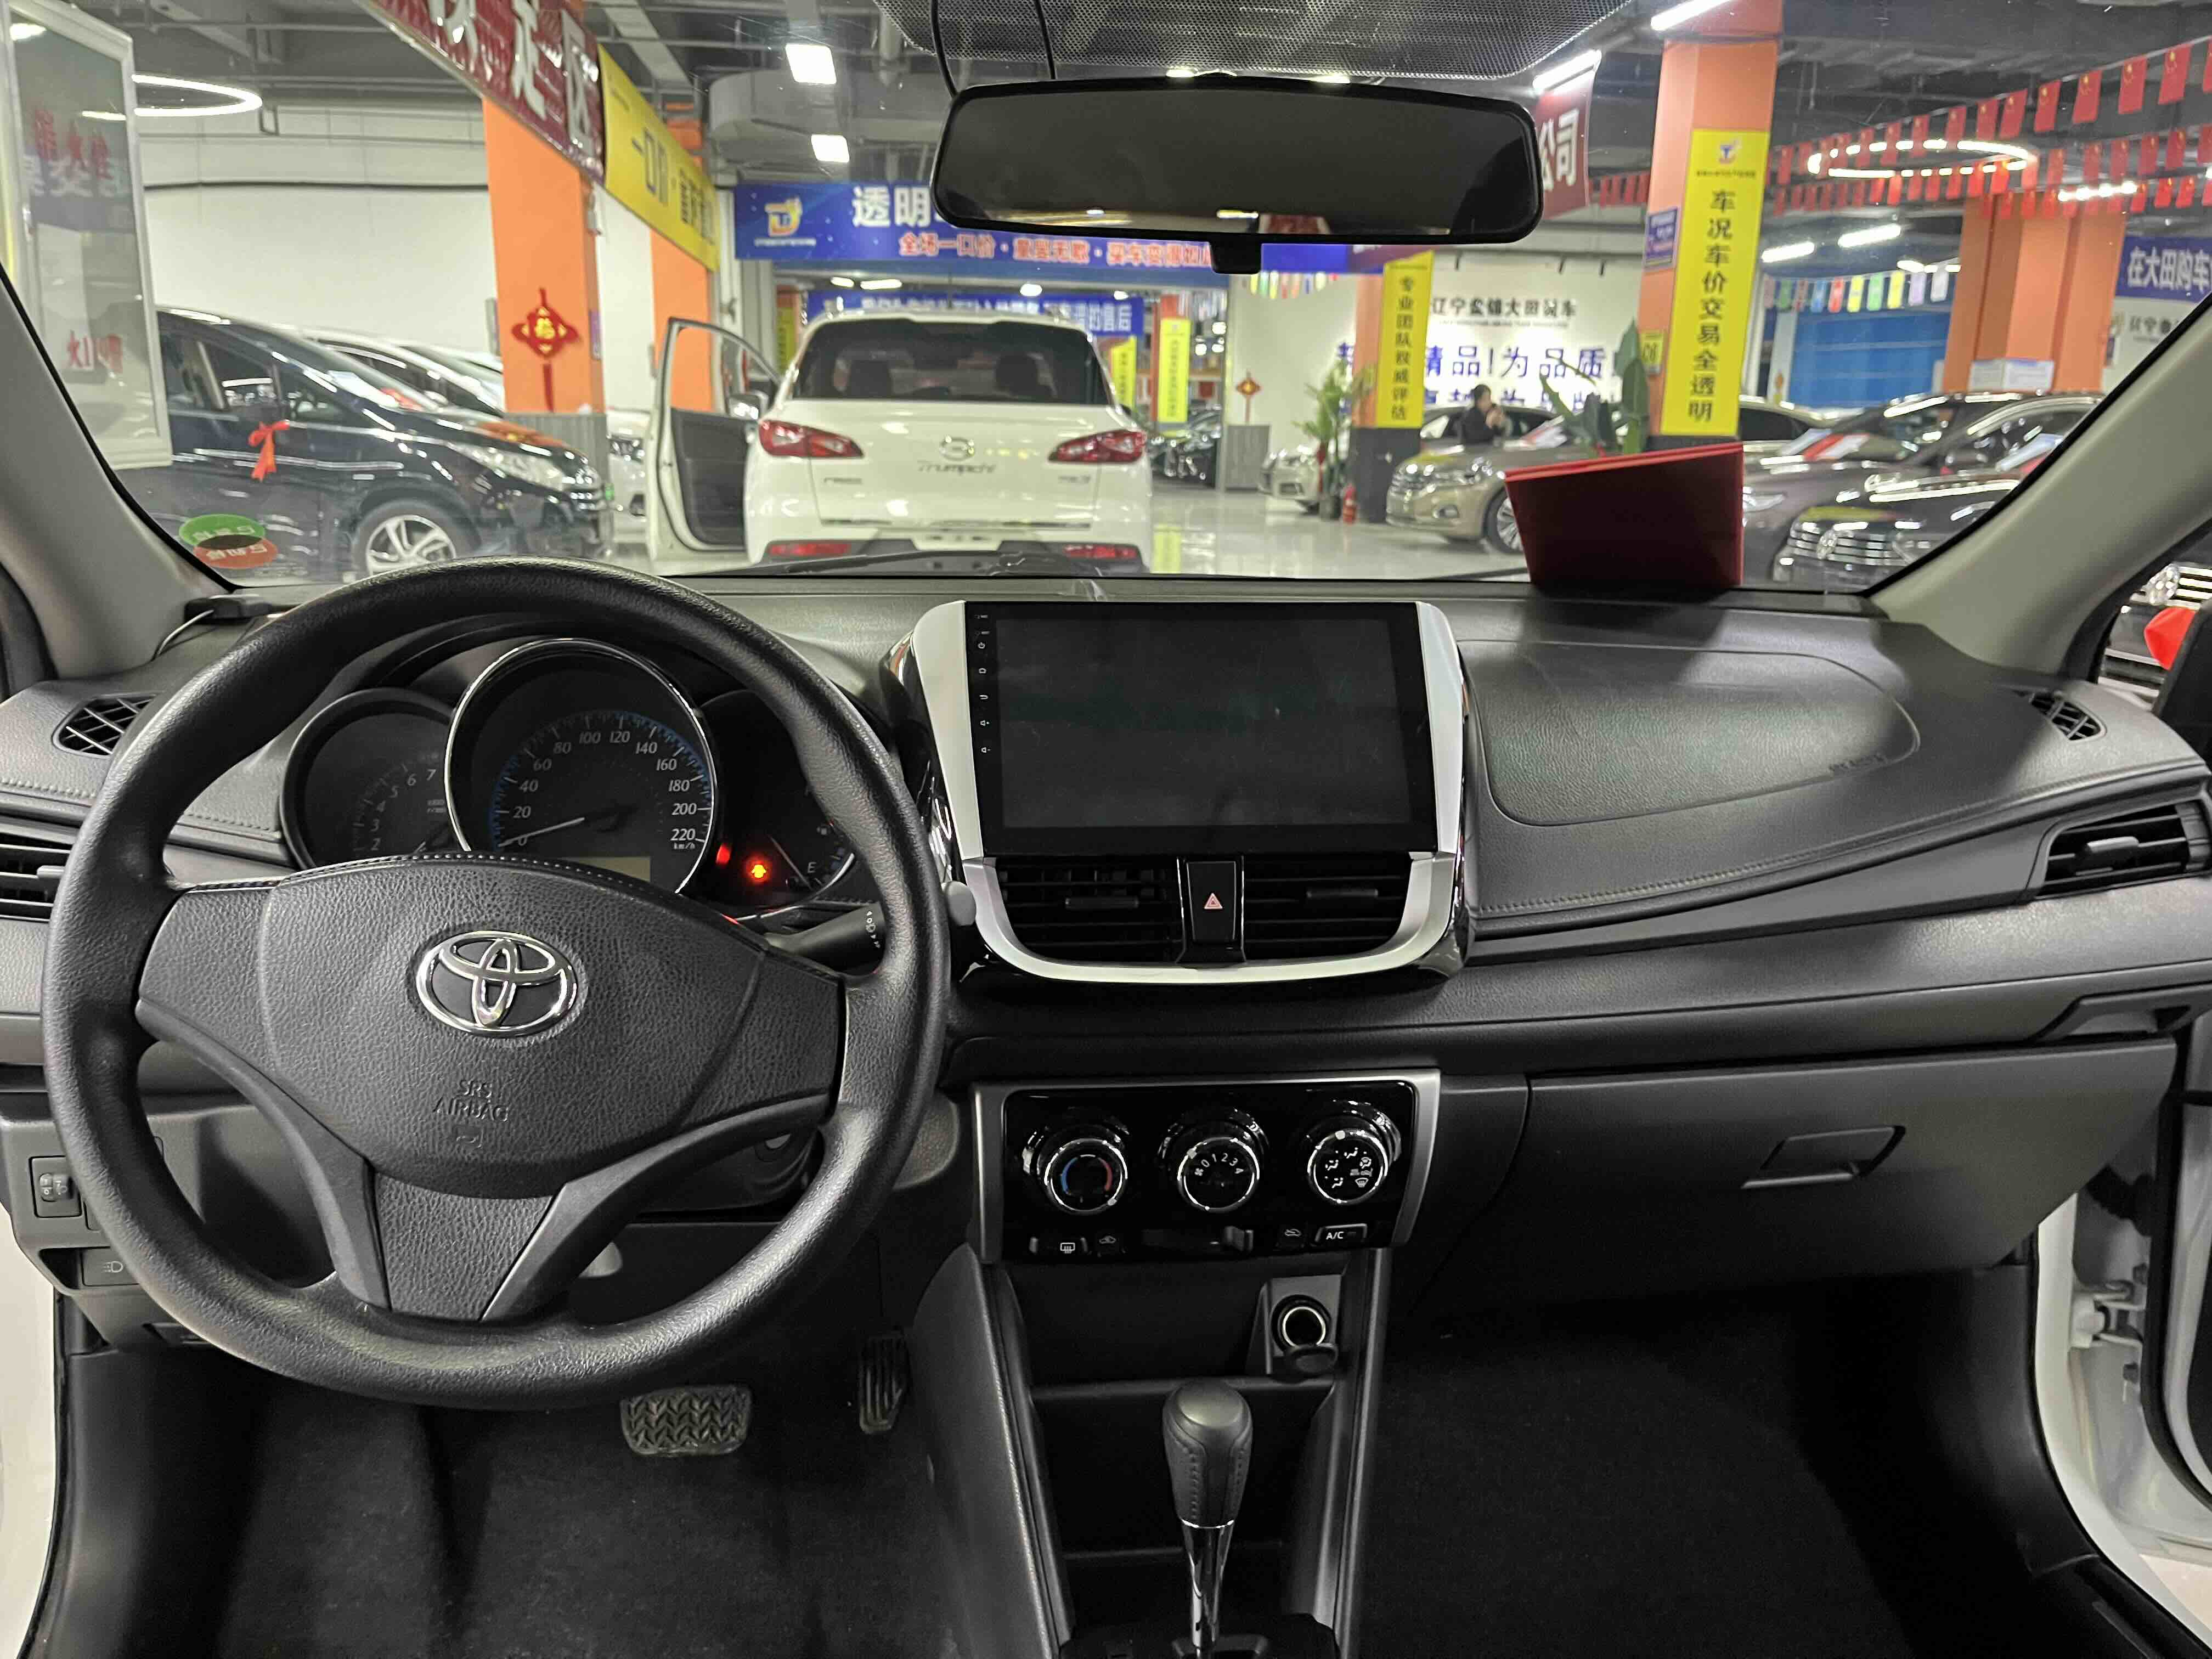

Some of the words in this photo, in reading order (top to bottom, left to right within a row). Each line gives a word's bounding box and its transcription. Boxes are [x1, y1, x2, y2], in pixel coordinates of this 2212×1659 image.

[851, 185, 955, 228] 透明
[2127, 245, 2212, 295] 在大田购车
[1688, 190, 1737, 422] 车况车价交易全透明
[579, 732, 601, 744] 100
[610, 731, 630, 743] 120
[553, 741, 572, 754] 80
[635, 742, 658, 754] 140
[533, 758, 552, 771] 60
[656, 759, 677, 771] 160
[407, 774, 416, 786] 6
[426, 769, 437, 781] 7
[389, 786, 399, 798] 5
[519, 779, 539, 793] 40
[668, 779, 690, 792] 180
[513, 805, 532, 819] 20
[672, 803, 698, 816] 200
[370, 819, 380, 832] 3
[670, 828, 696, 841] 220
[370, 838, 381, 851] 2
[673, 842, 695, 850] km/h
[807, 861, 817, 873] E
[432, 1097, 510, 1122] AIRBAG
[1201, 1159, 1210, 1168] 0
[1212, 1153, 1217, 1163] 1
[1221, 1153, 1228, 1163] 2
[1229, 1158, 1239, 1167] 3
[1325, 1231, 1345, 1240] A/C
